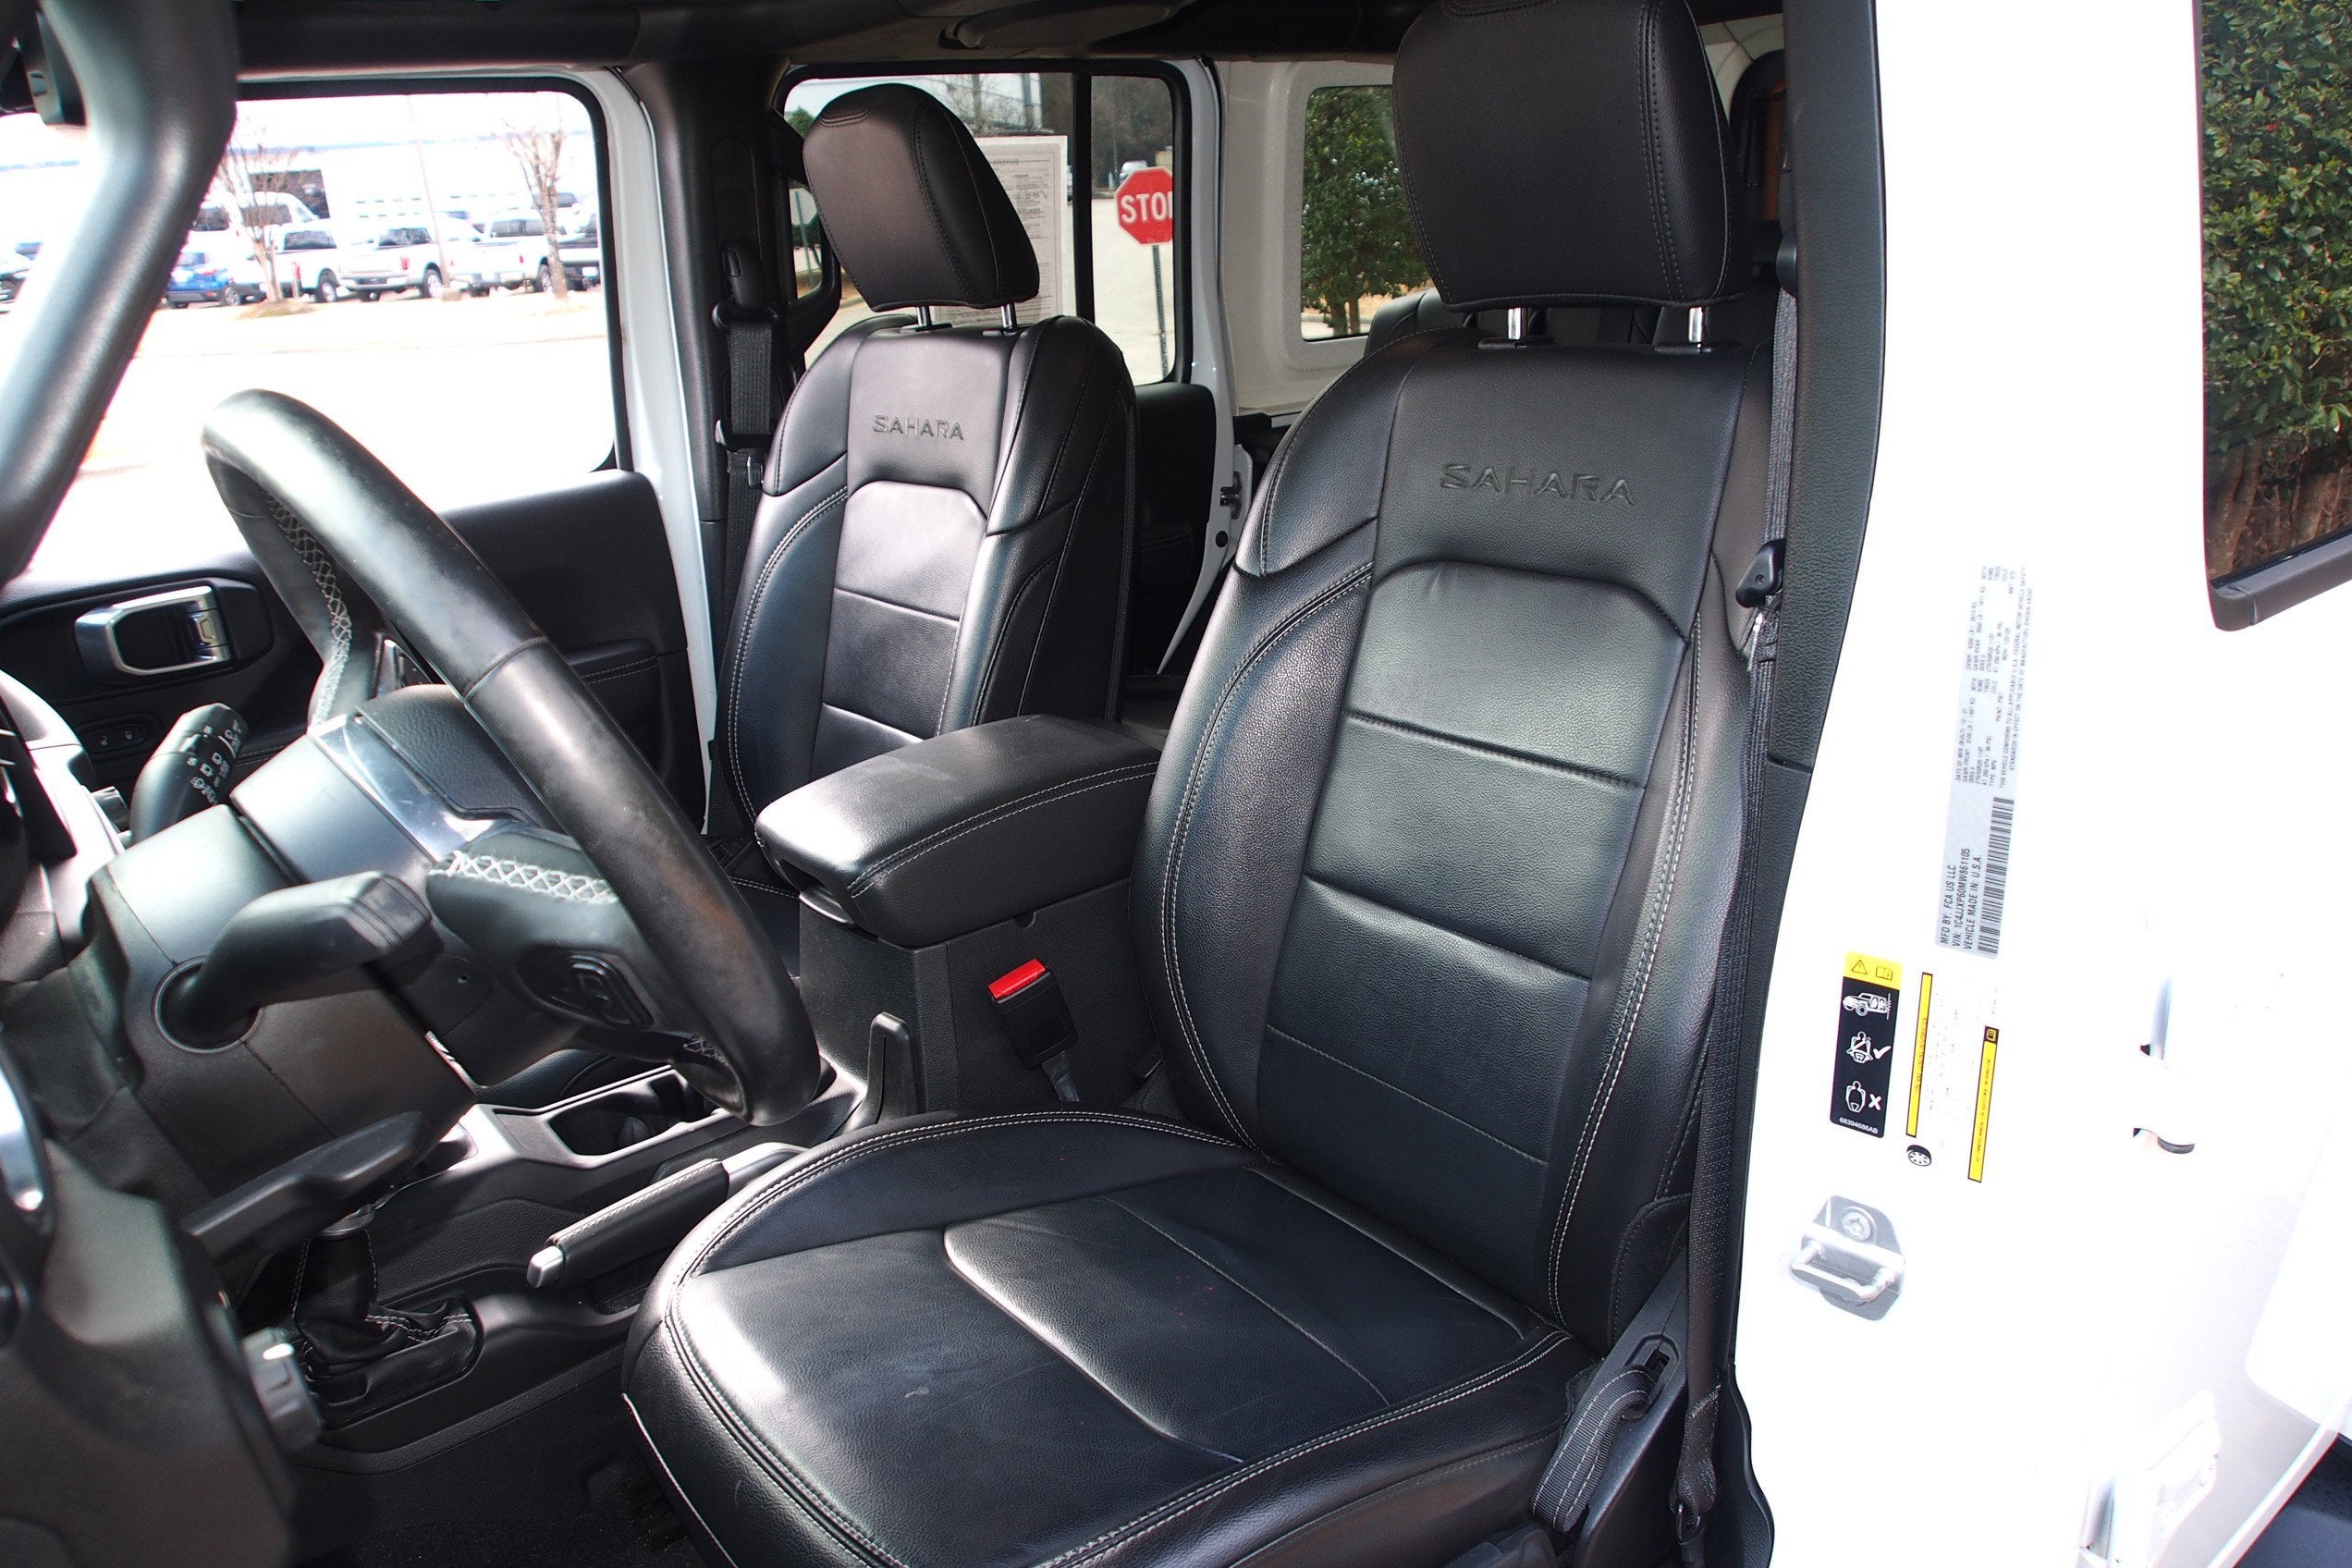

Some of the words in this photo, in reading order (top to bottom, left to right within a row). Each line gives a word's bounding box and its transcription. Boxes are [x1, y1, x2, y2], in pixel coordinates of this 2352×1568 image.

[873, 414, 963, 441] SAHARA
[1439, 463, 1637, 505] SAHARA
[1946, 864, 1957, 879] LLC
[1971, 854, 1982, 877] U.S.A.
[1945, 881, 1955, 892] US
[1969, 880, 1979, 892] IN:
[1943, 894, 1954, 909] FCA
[1967, 893, 1978, 916] MADE
[1942, 913, 1952, 925] BY:
[1940, 927, 1950, 944] MFD
[1952, 931, 1962, 947] VIN:
[1964, 918, 1975, 950] VEHICLE
